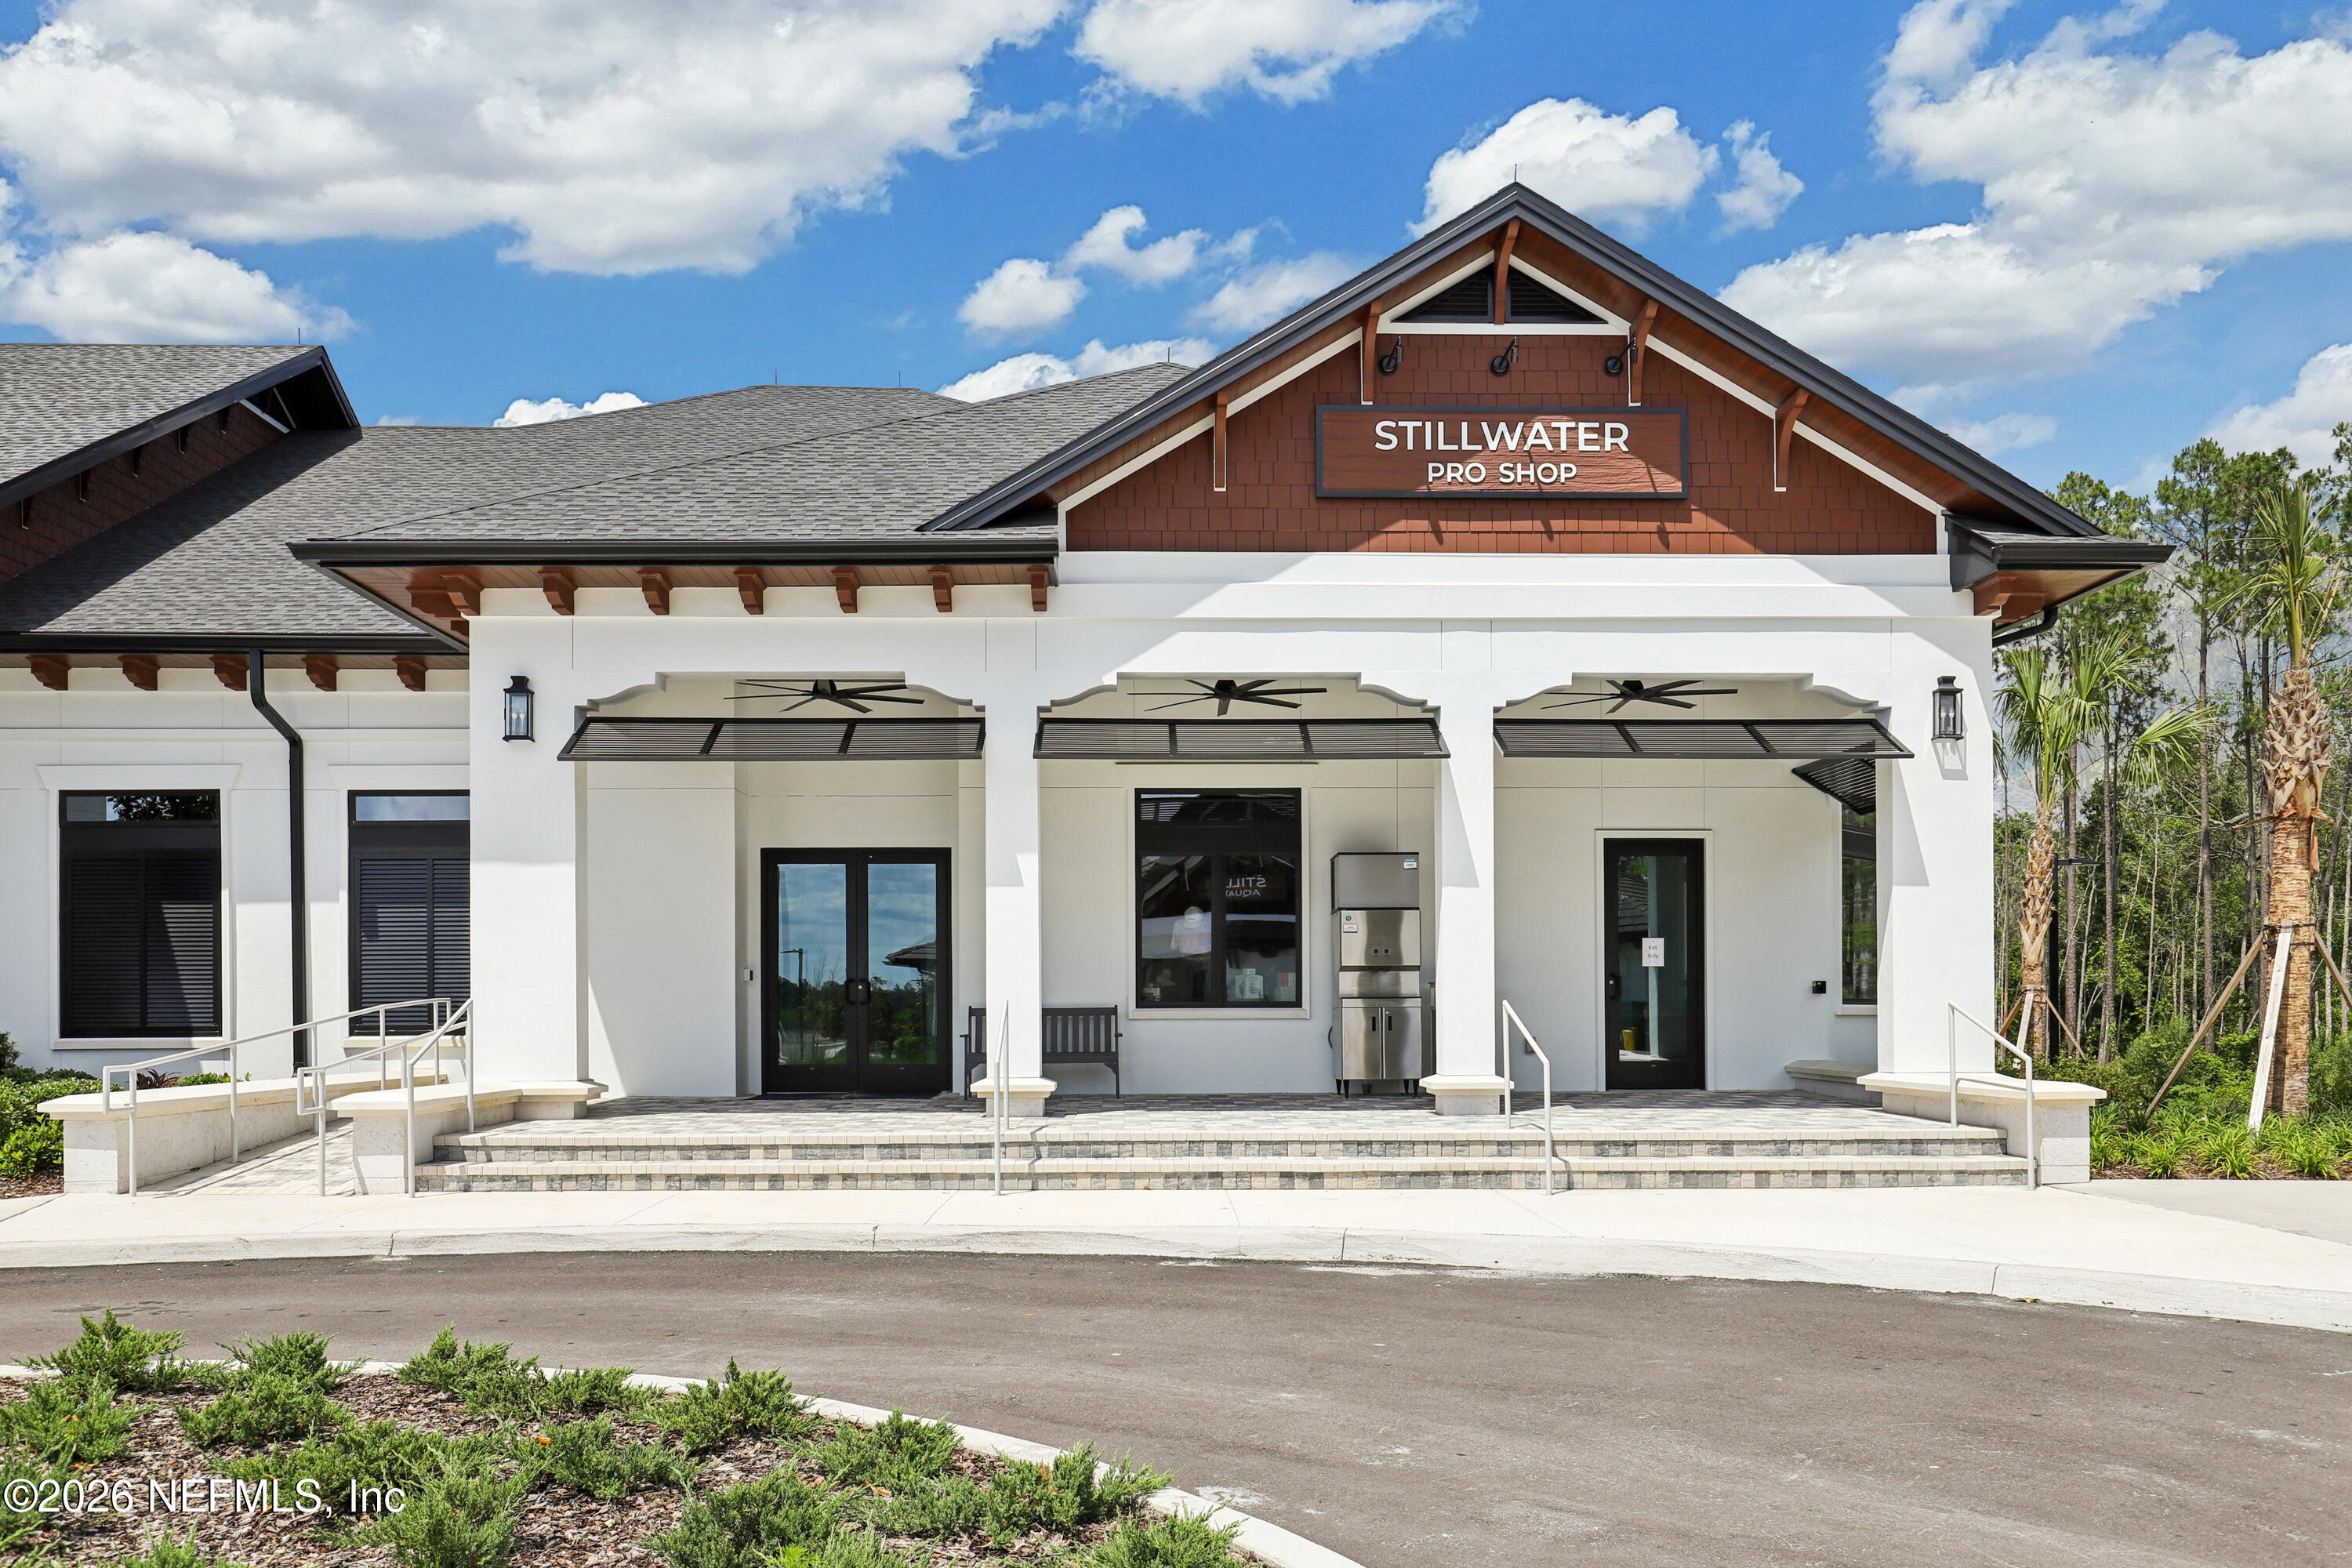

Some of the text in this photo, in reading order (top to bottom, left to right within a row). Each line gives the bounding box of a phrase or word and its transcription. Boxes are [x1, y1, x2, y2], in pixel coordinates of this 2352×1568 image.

[1374, 420, 1630, 452] STILLWATER
[1428, 462, 1577, 484] PRO SHOP
